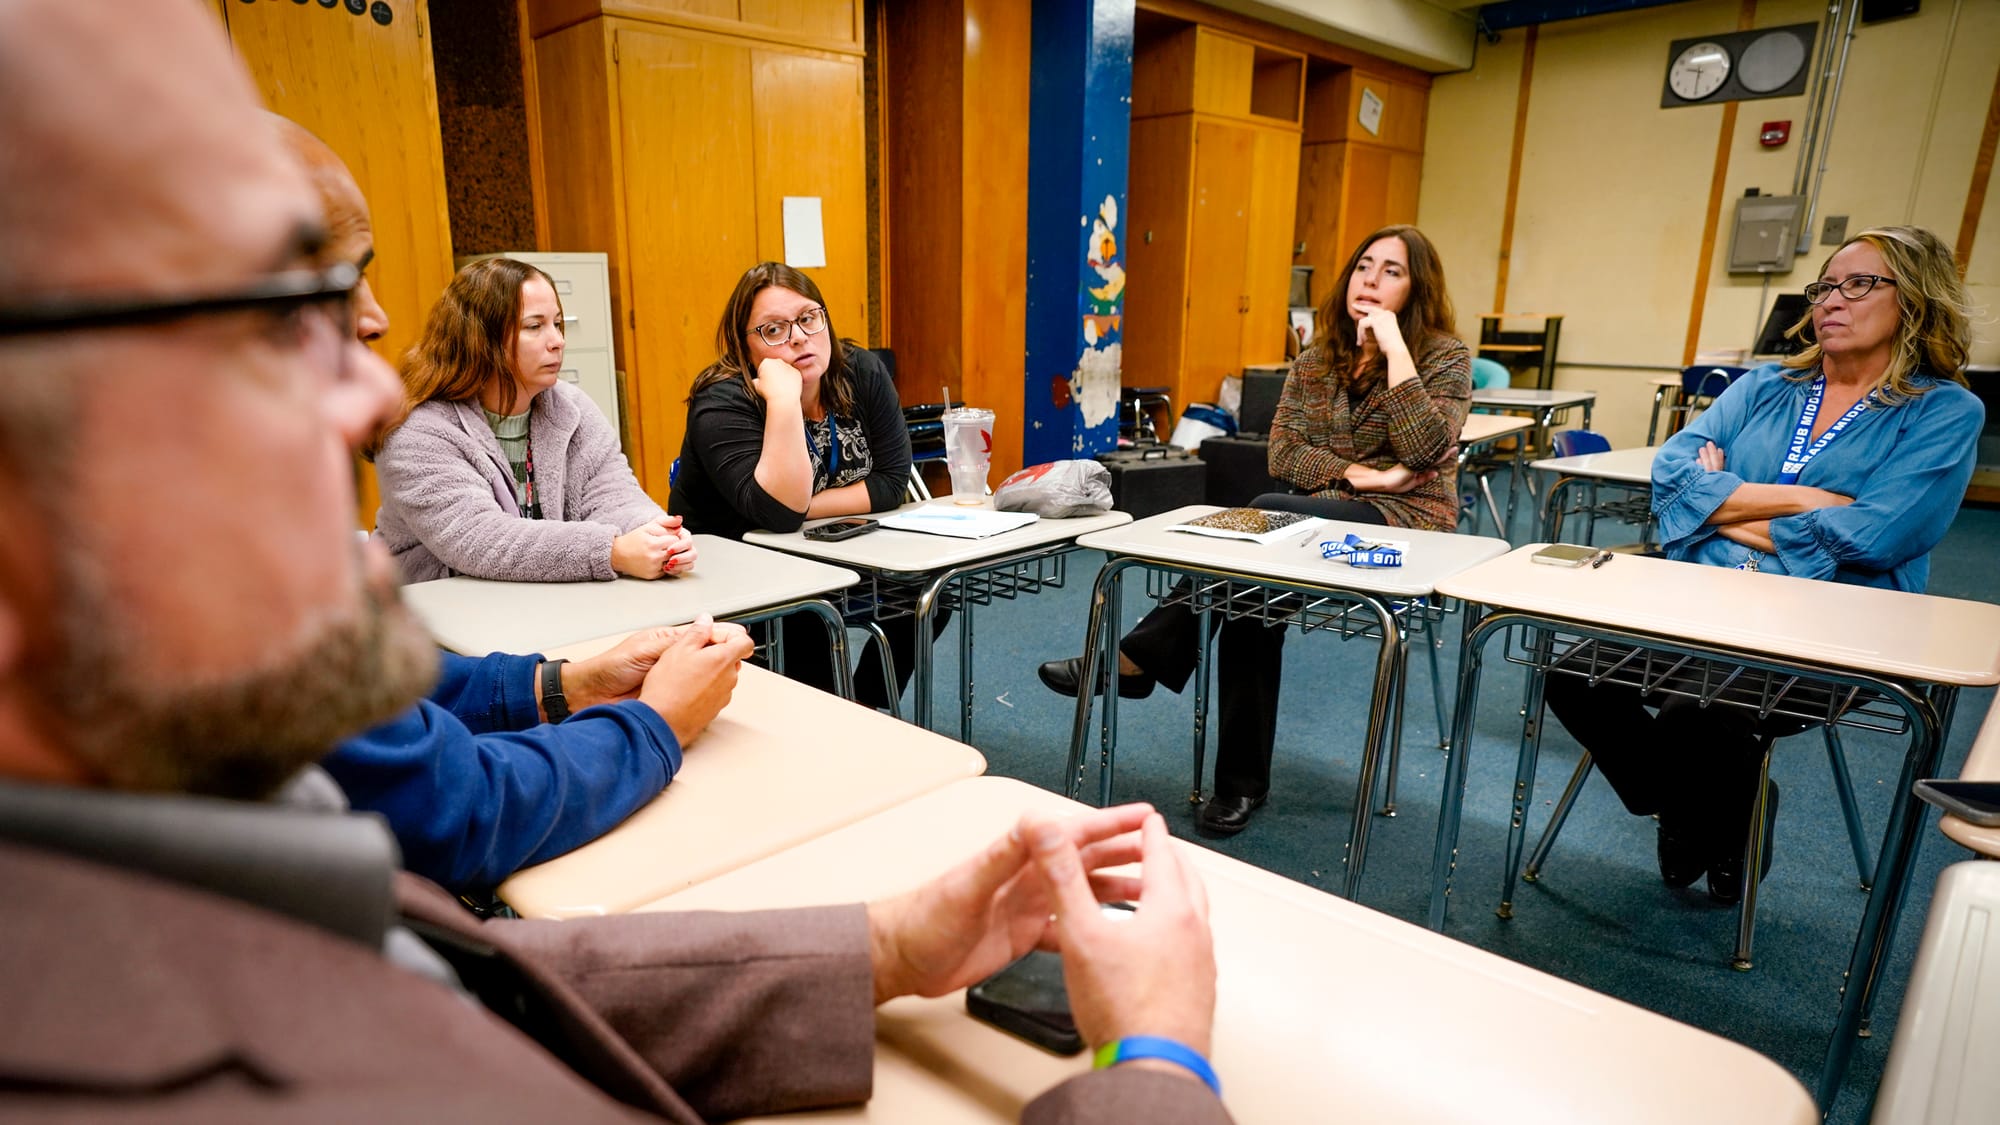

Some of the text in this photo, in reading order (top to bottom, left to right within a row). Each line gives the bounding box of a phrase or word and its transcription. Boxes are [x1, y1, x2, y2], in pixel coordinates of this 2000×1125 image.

[1787, 427, 1809, 462] RAUB
[1800, 383, 1823, 426] MIDDLE
[1800, 432, 1836, 462] RAUB
